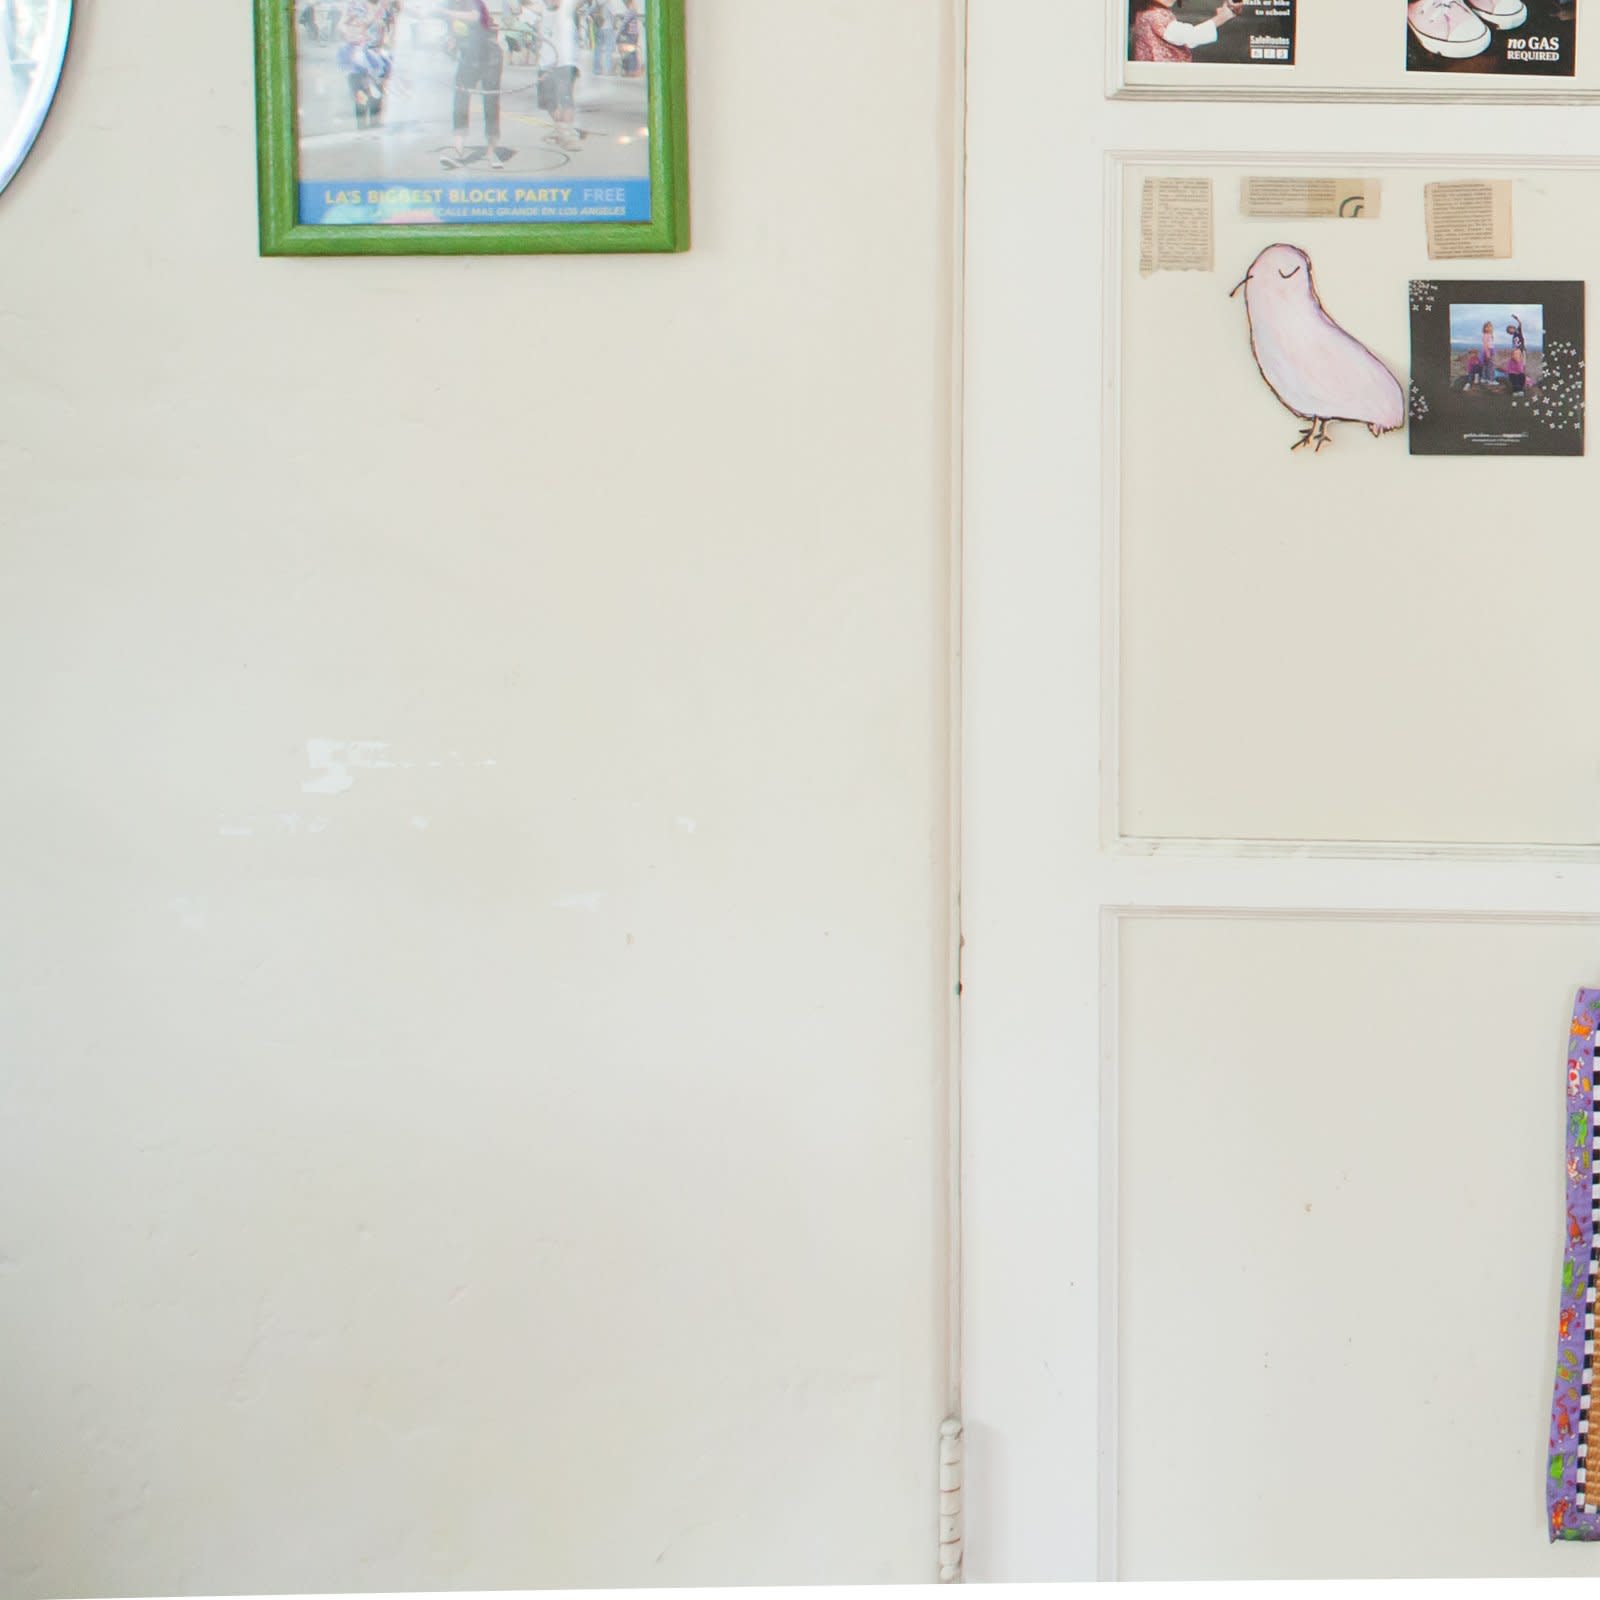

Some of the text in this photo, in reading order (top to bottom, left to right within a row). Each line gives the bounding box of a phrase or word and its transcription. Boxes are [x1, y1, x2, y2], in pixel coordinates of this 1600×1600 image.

[1507, 36, 1560, 51] no GAS
[1507, 50, 1560, 61] REQUIRED
[325, 190, 362, 205] LA'S
[449, 189, 509, 204] BLOCK
[515, 188, 572, 203] PARTY
[584, 188, 626, 202] FREE
